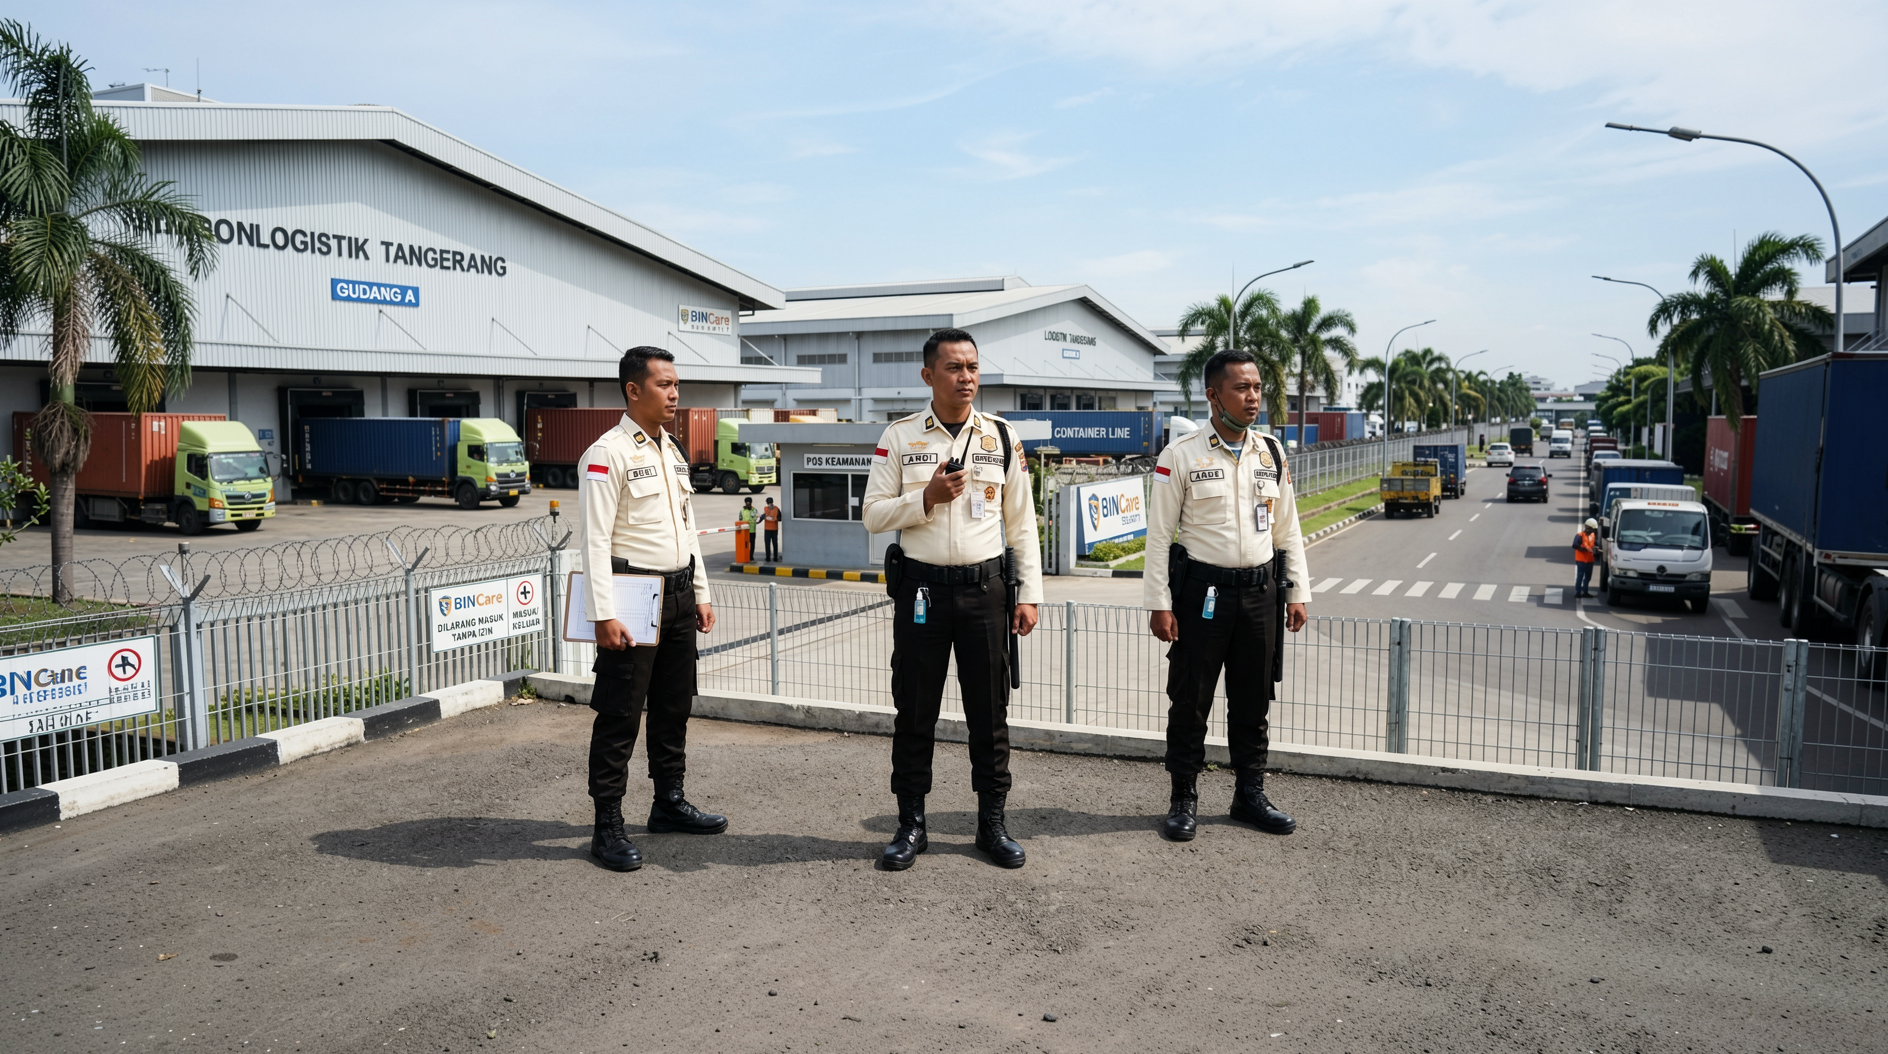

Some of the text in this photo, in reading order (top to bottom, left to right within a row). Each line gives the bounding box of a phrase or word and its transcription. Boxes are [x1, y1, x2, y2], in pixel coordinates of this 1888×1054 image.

[381, 241, 507, 277] TANGERANG
[336, 282, 416, 303] GUDANG A
[1054, 427, 1130, 438] CONTAINER LINE
[806, 457, 872, 466] POS KEAMANAN
[1101, 493, 1140, 518] BINCare
[454, 593, 503, 610] BINCare
[437, 618, 476, 633] DILARANG
[452, 630, 477, 642] TANPA
